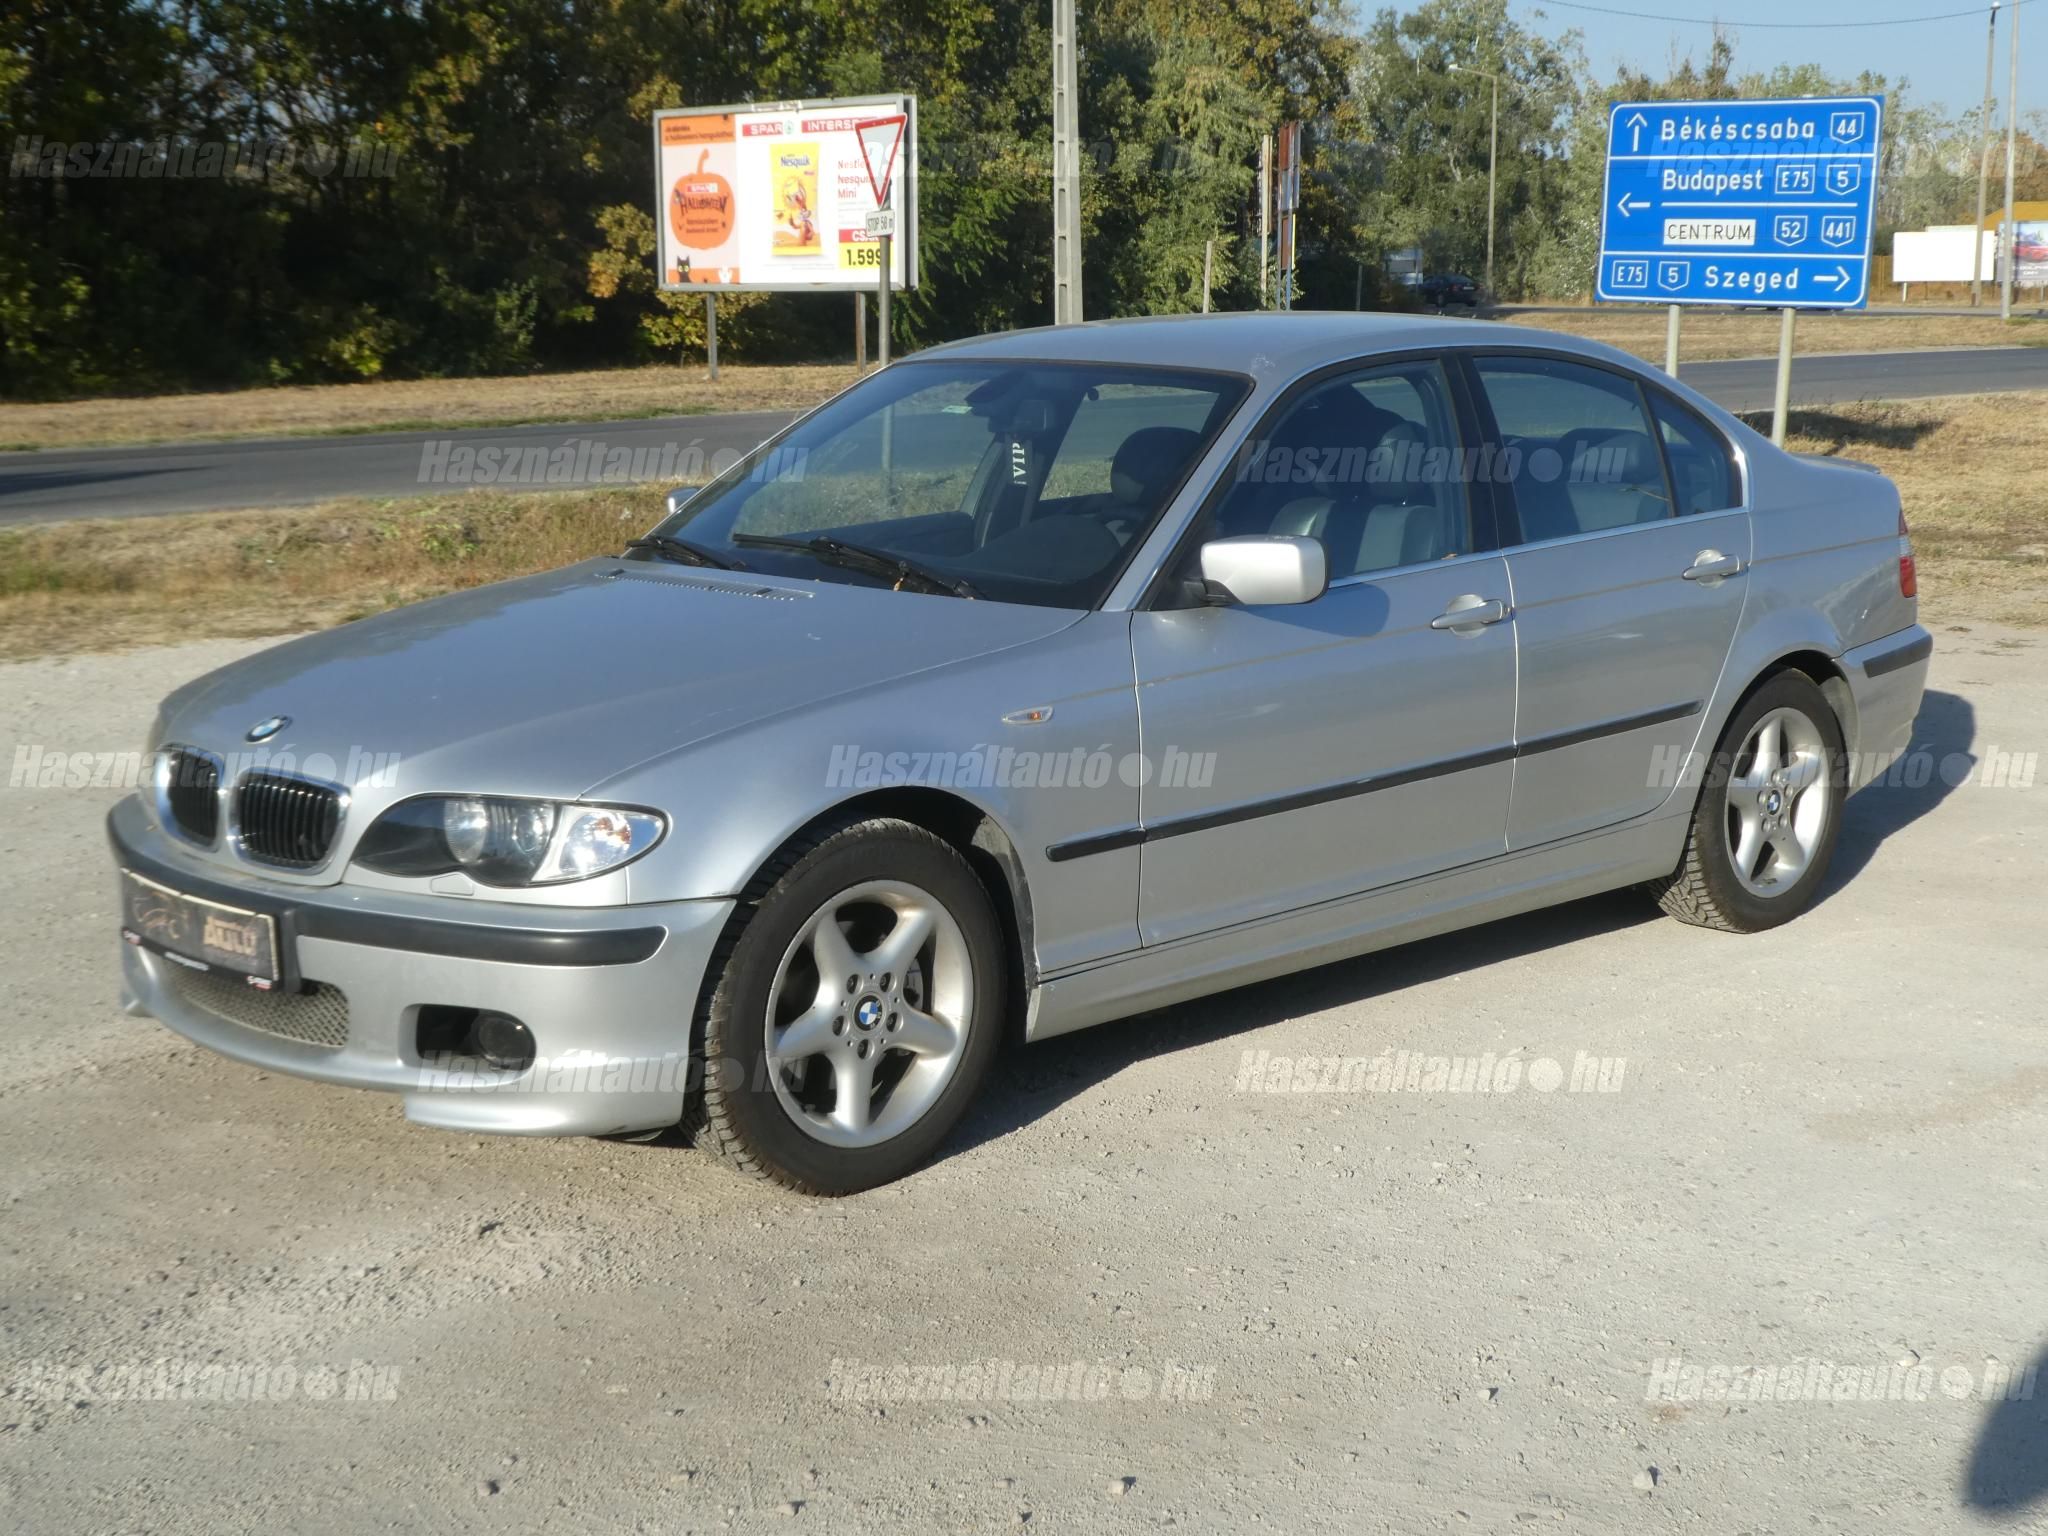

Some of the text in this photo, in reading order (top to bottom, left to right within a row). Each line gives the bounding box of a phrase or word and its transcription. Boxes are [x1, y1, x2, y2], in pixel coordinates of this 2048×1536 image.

[751, 123, 783, 135] SPAR
[1660, 115, 1857, 141] Békéscsaba 44
[838, 174, 871, 186] Nesqui
[1662, 169, 1764, 195] Budapest
[1837, 171, 1849, 188] 5
[838, 187, 857, 199] Mini
[867, 217, 880, 232] STOP
[1667, 221, 1851, 241] CENTRUM 52 441
[1667, 267, 1679, 283] 5
[1704, 265, 1799, 293] Szeged
